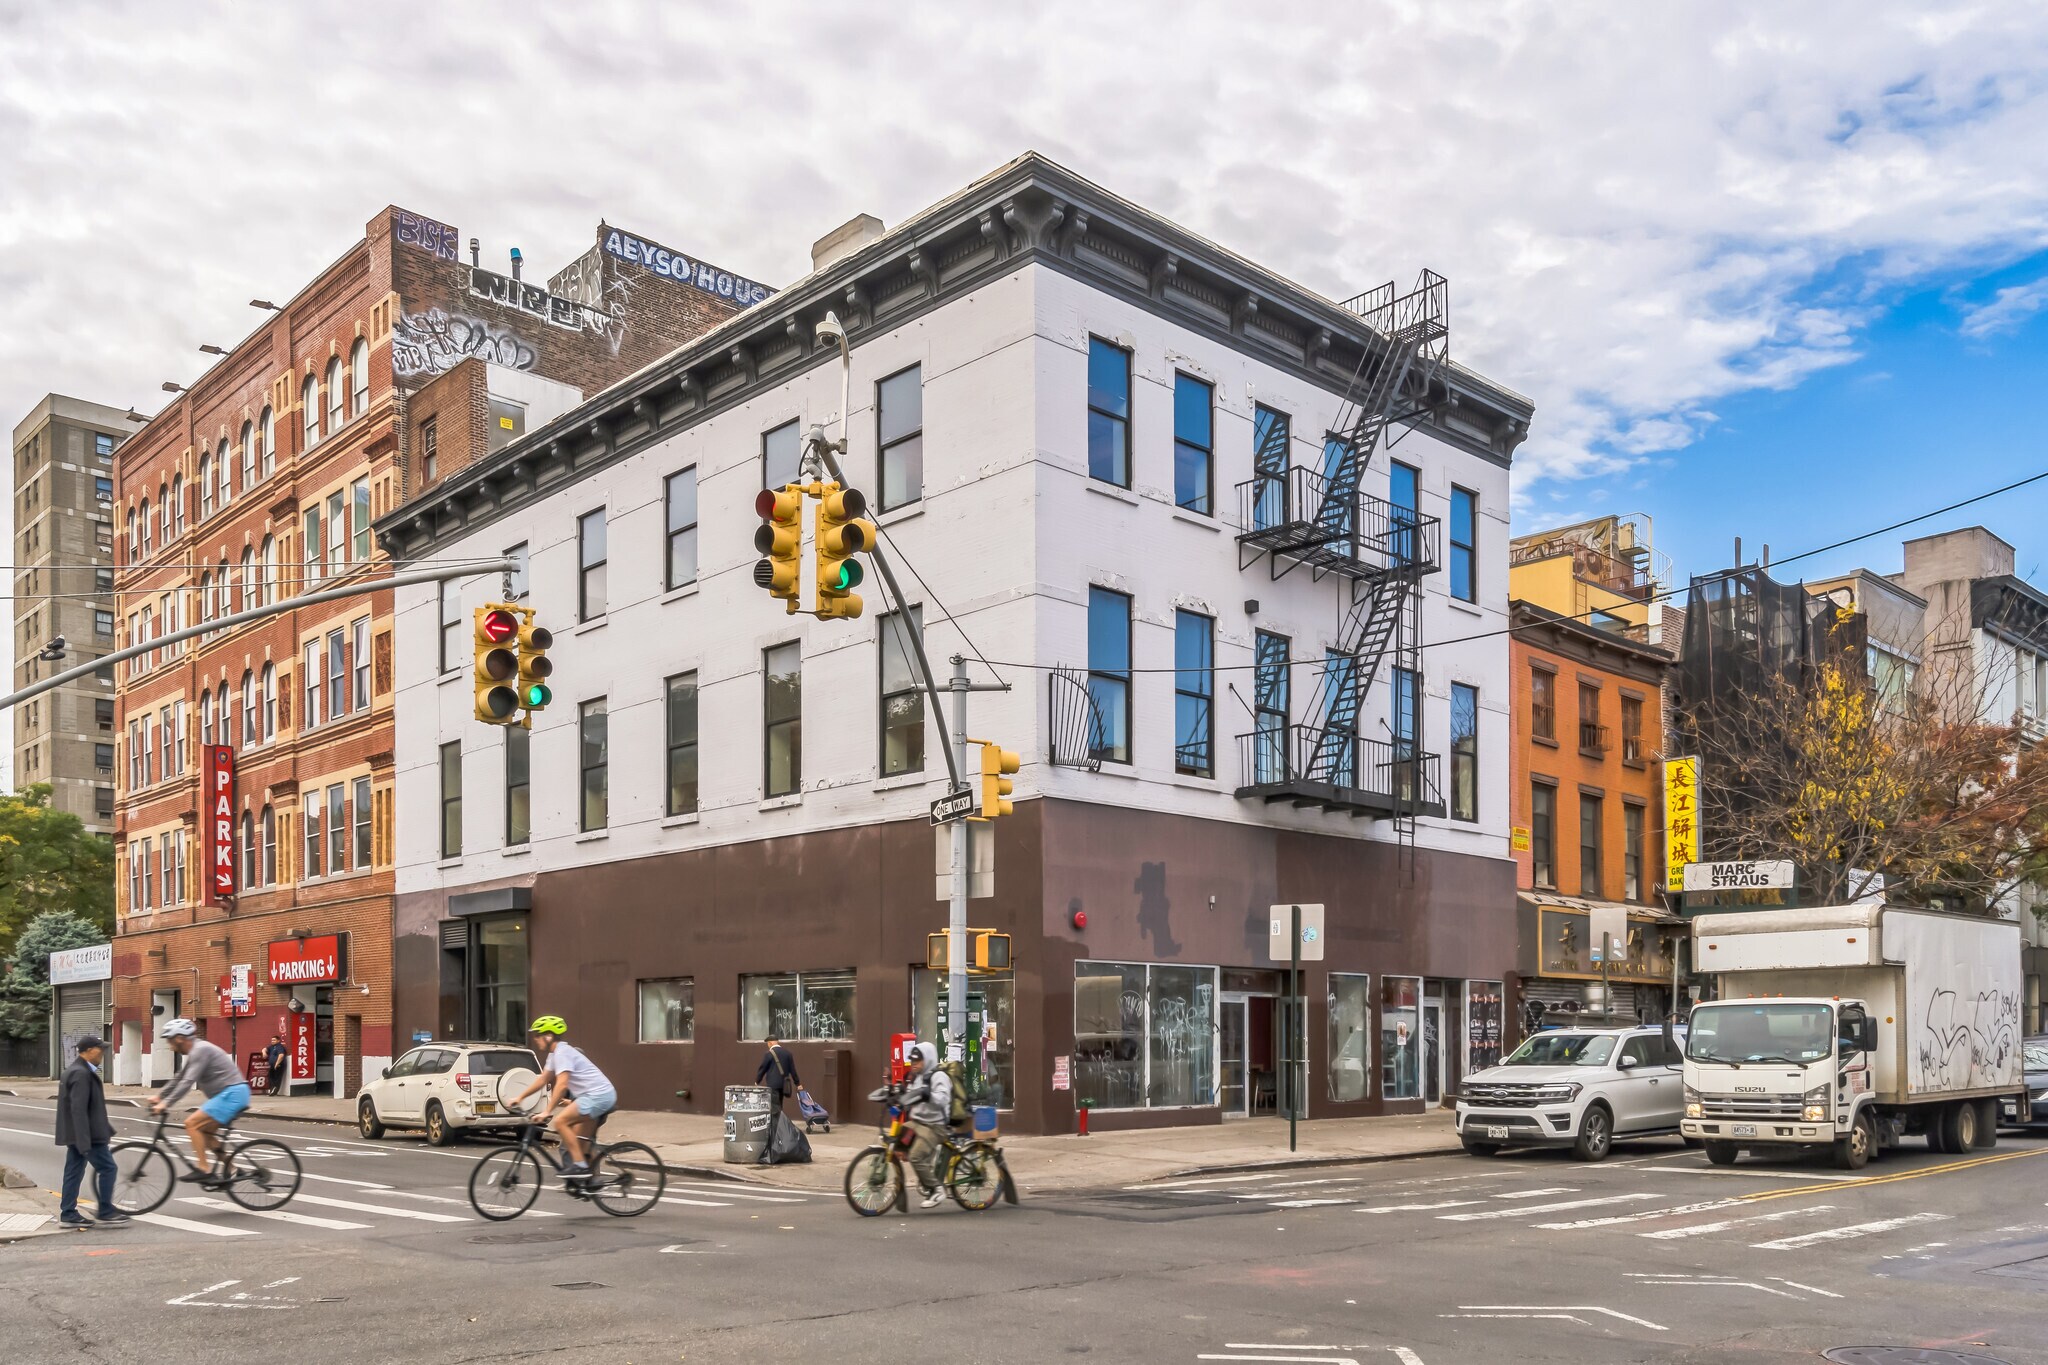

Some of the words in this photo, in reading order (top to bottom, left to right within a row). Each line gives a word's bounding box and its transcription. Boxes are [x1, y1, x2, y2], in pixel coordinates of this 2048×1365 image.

[697, 264, 778, 304] HOUS
[936, 804, 949, 816] ONE
[953, 797, 968, 811] WAY
[1670, 766, 1692, 864] 長江餅城
[216, 770, 232, 867] PARK
[1671, 867, 1684, 875] GRE
[1711, 864, 1755, 876] MARC
[1669, 878, 1683, 886] BAK
[1711, 874, 1769, 887] STRAUS
[279, 959, 325, 980] PARKING
[298, 1026, 308, 1066] PARK
[250, 1076, 266, 1088] 18
